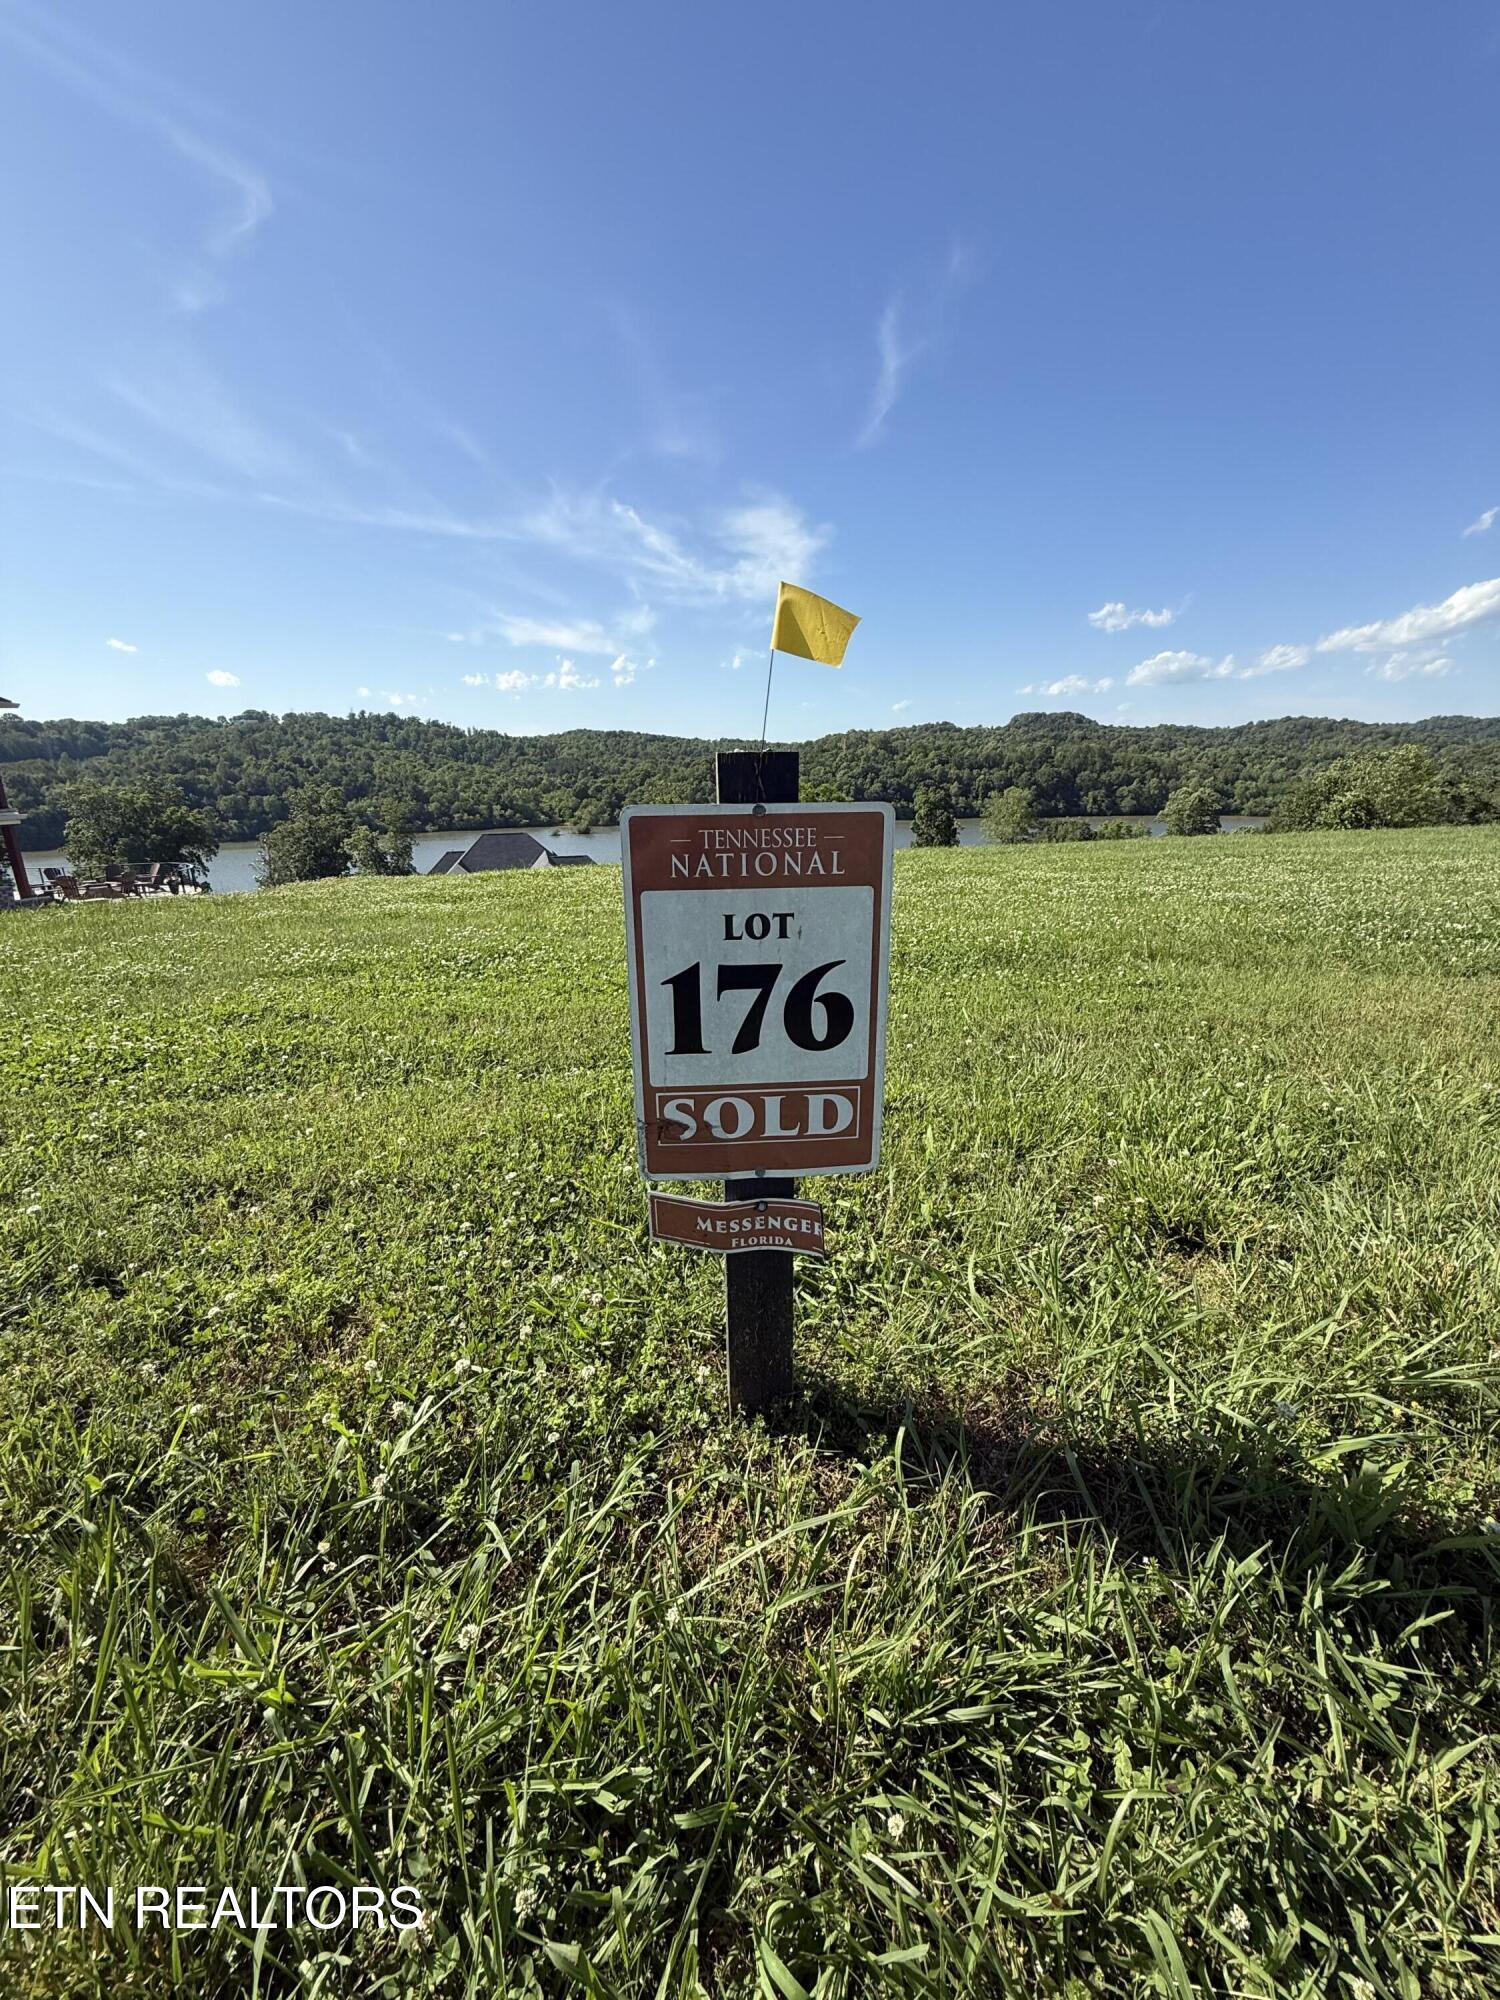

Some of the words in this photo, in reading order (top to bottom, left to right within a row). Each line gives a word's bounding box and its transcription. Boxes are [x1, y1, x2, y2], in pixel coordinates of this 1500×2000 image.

[698, 828, 817, 849] TENNESSEE
[670, 851, 845, 878] NATIONAL
[722, 913, 795, 940] LOT
[660, 959, 855, 1055] 176
[663, 1093, 854, 1141] SOLD
[731, 1235, 793, 1248] FLORIDA
